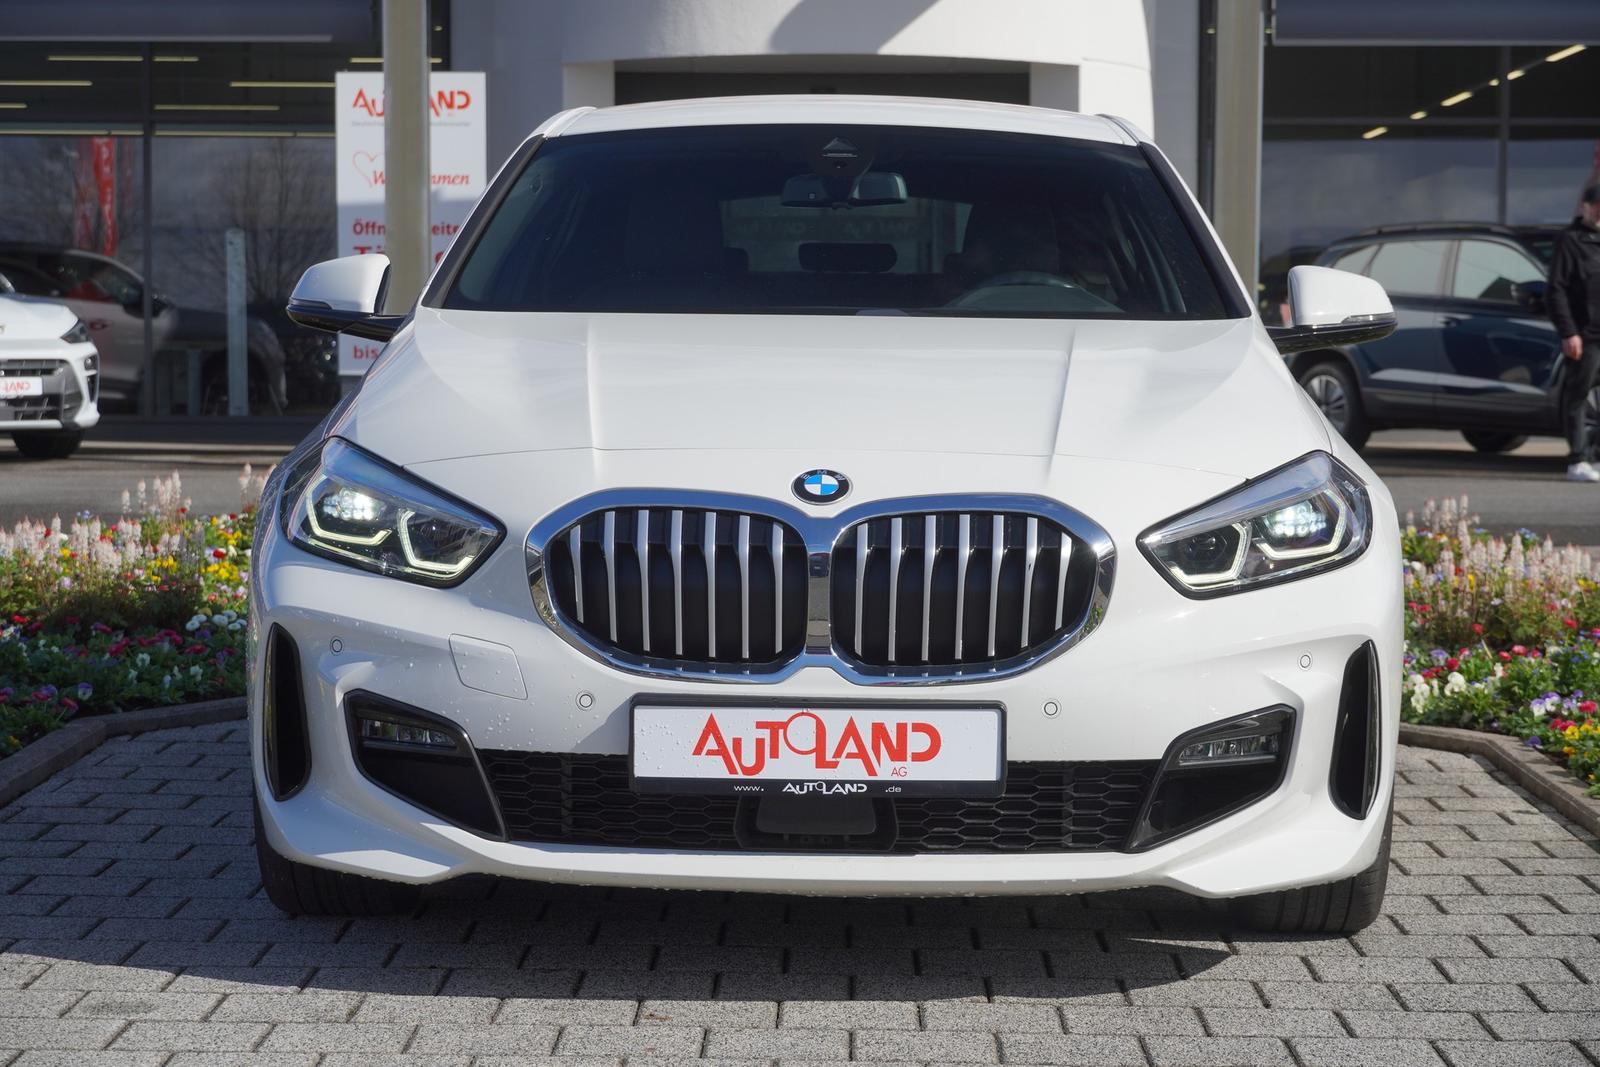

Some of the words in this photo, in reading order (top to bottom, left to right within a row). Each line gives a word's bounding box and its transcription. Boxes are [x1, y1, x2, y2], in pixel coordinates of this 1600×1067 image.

[692, 711, 942, 777] AUTOLAND
[890, 767, 908, 778] AG
[782, 780, 868, 796] AUTOLAND
